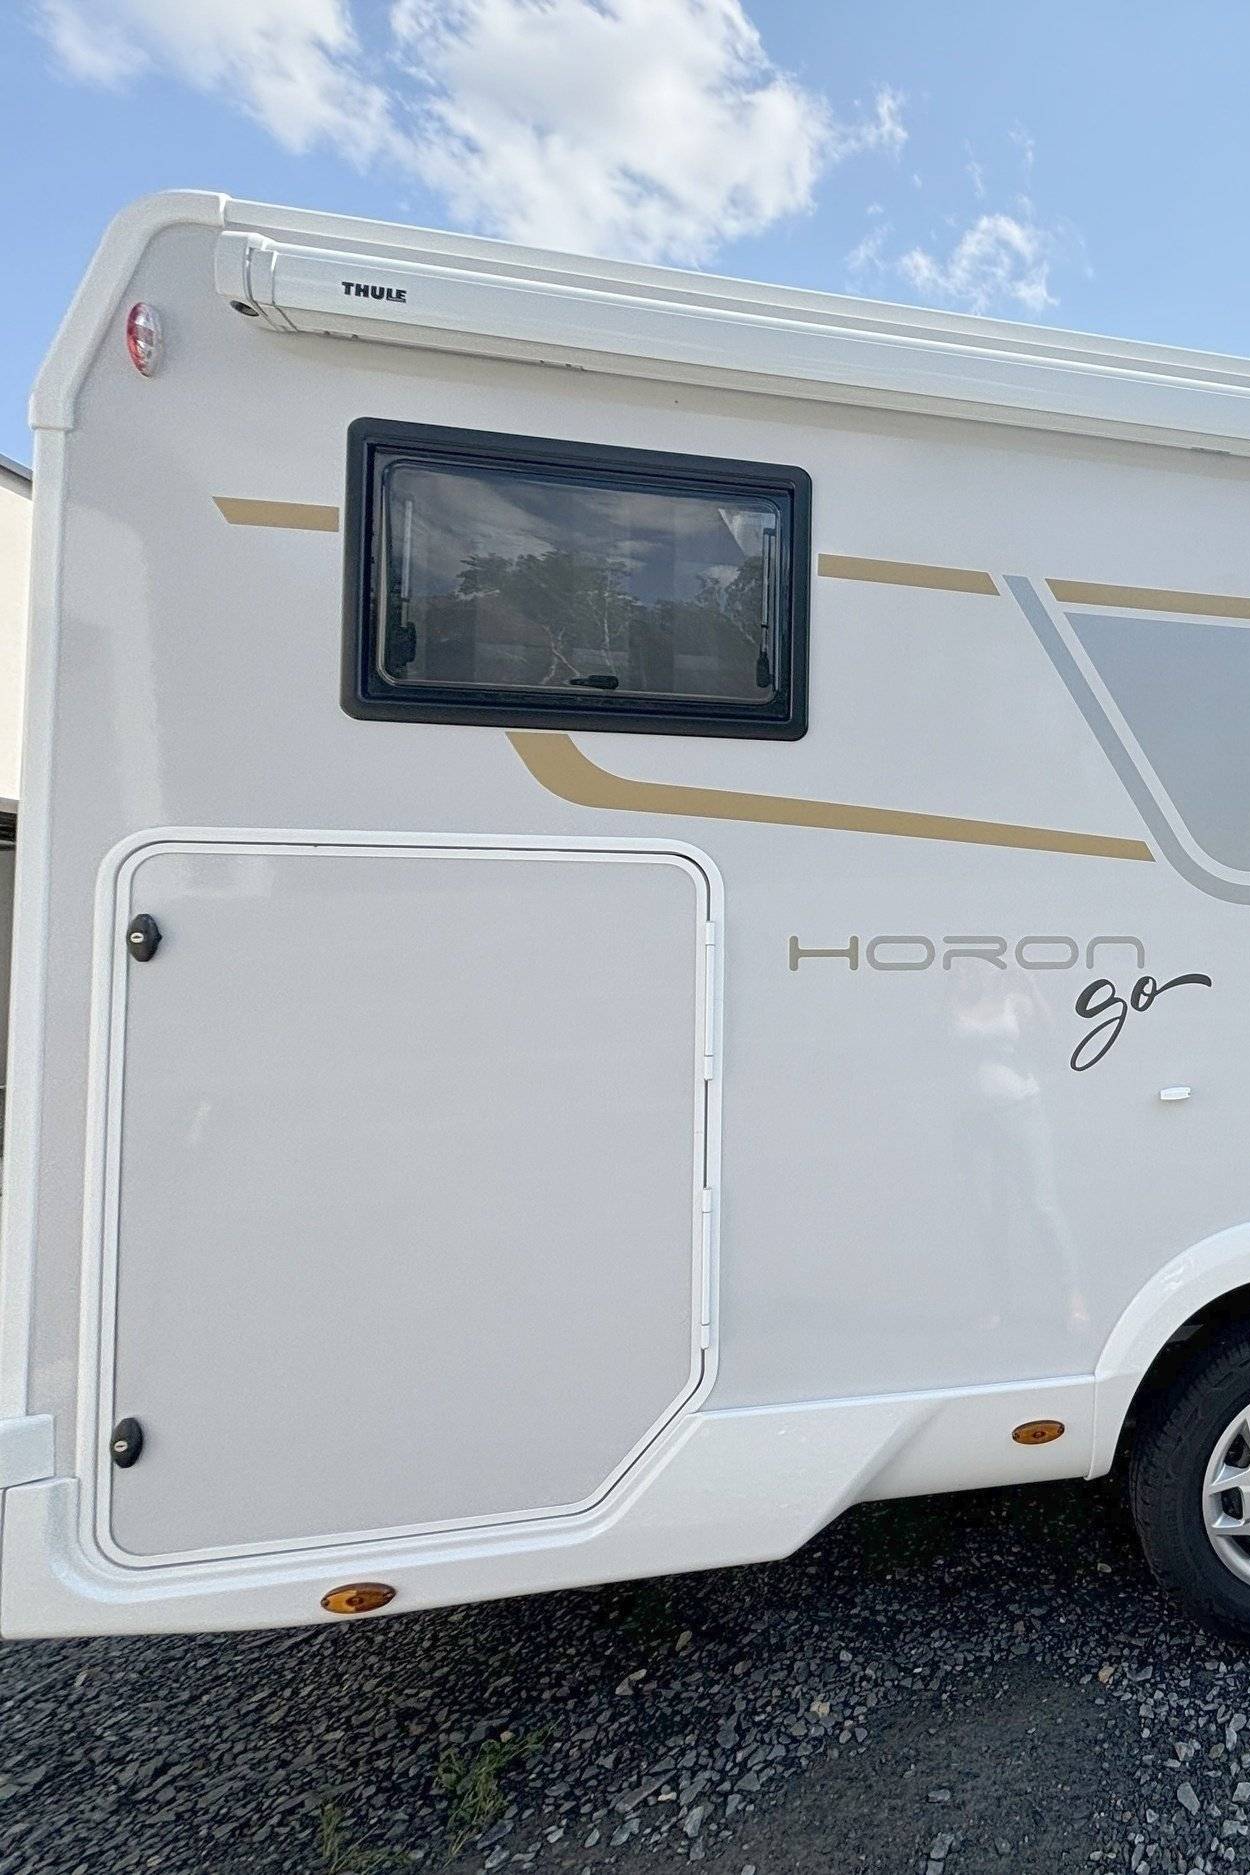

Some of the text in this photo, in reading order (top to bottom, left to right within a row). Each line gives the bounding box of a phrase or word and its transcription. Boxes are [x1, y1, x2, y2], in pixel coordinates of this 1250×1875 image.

[341, 281, 407, 301] THULE
[789, 935, 1145, 971] HORON
[1070, 973, 1212, 1072] go
